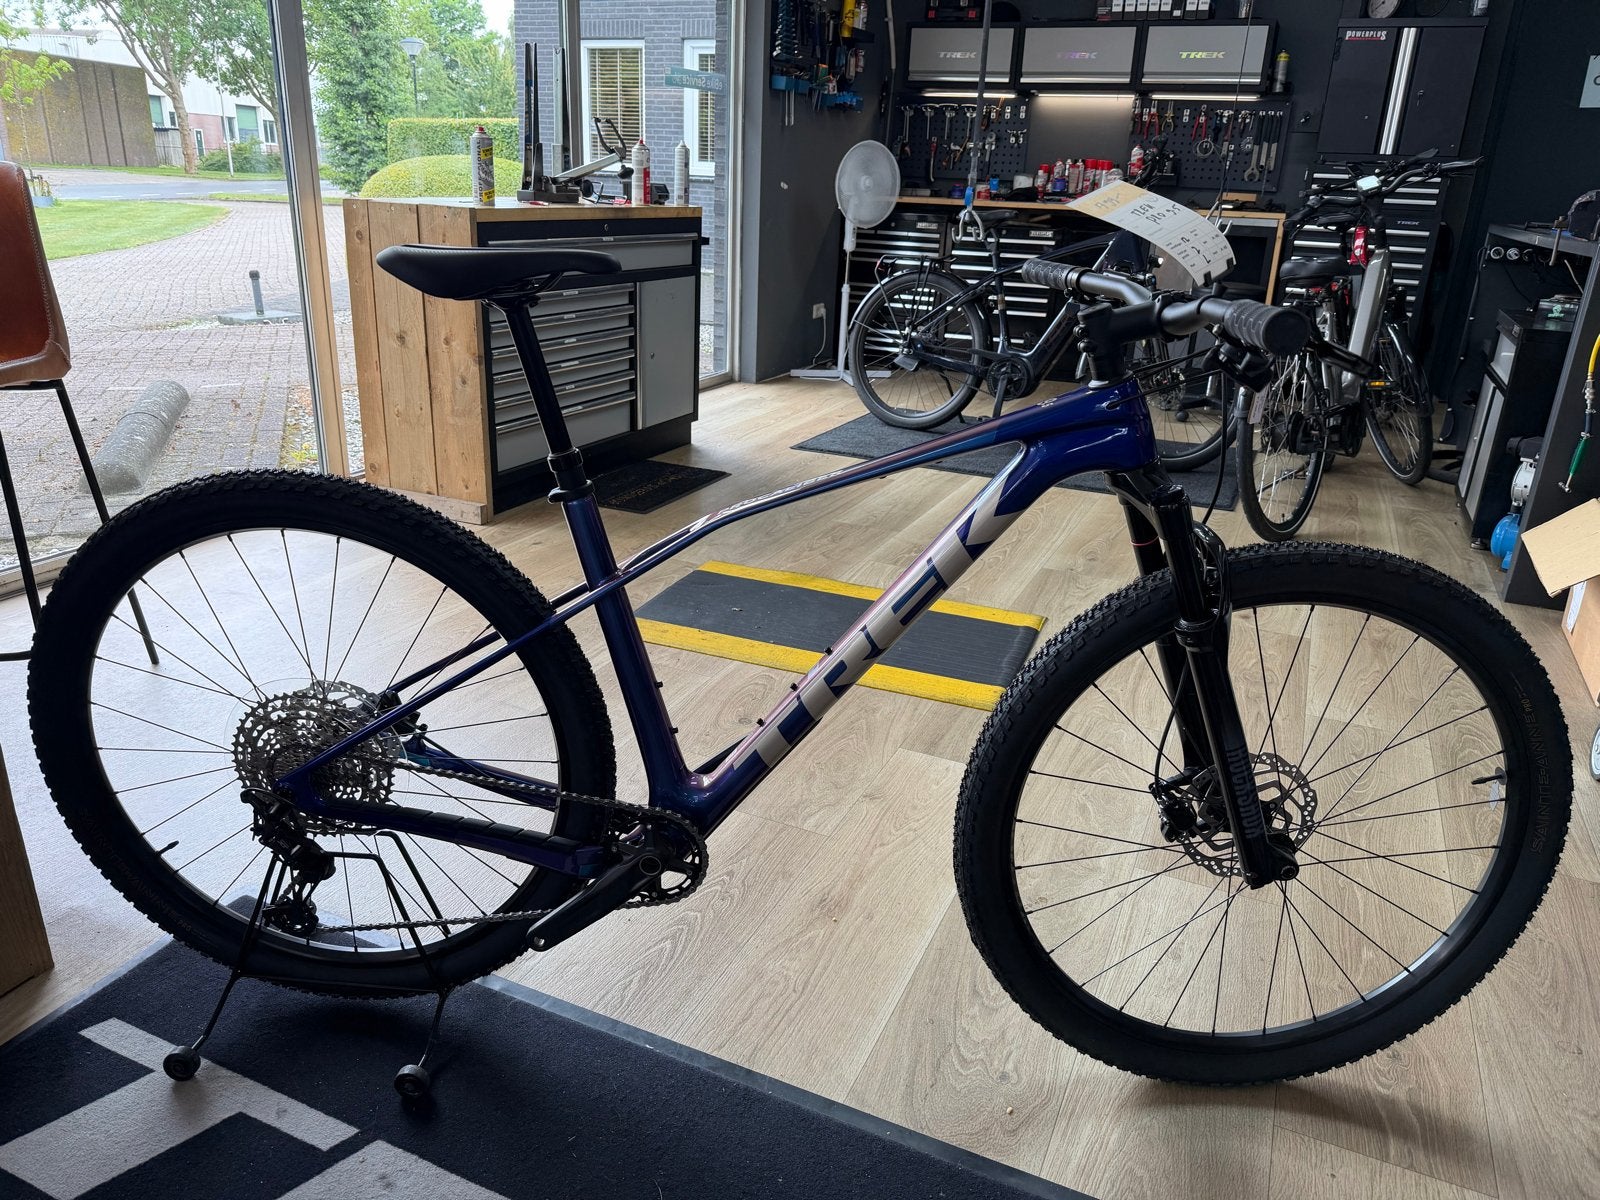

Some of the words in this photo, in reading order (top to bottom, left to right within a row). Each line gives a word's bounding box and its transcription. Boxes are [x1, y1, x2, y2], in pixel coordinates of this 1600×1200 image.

[1345, 30, 1389, 40] POWERPLUS
[936, 51, 977, 59] TREK
[1055, 51, 1097, 60] TREK
[1178, 51, 1226, 60] TREK
[733, 472, 1026, 771] TREK
